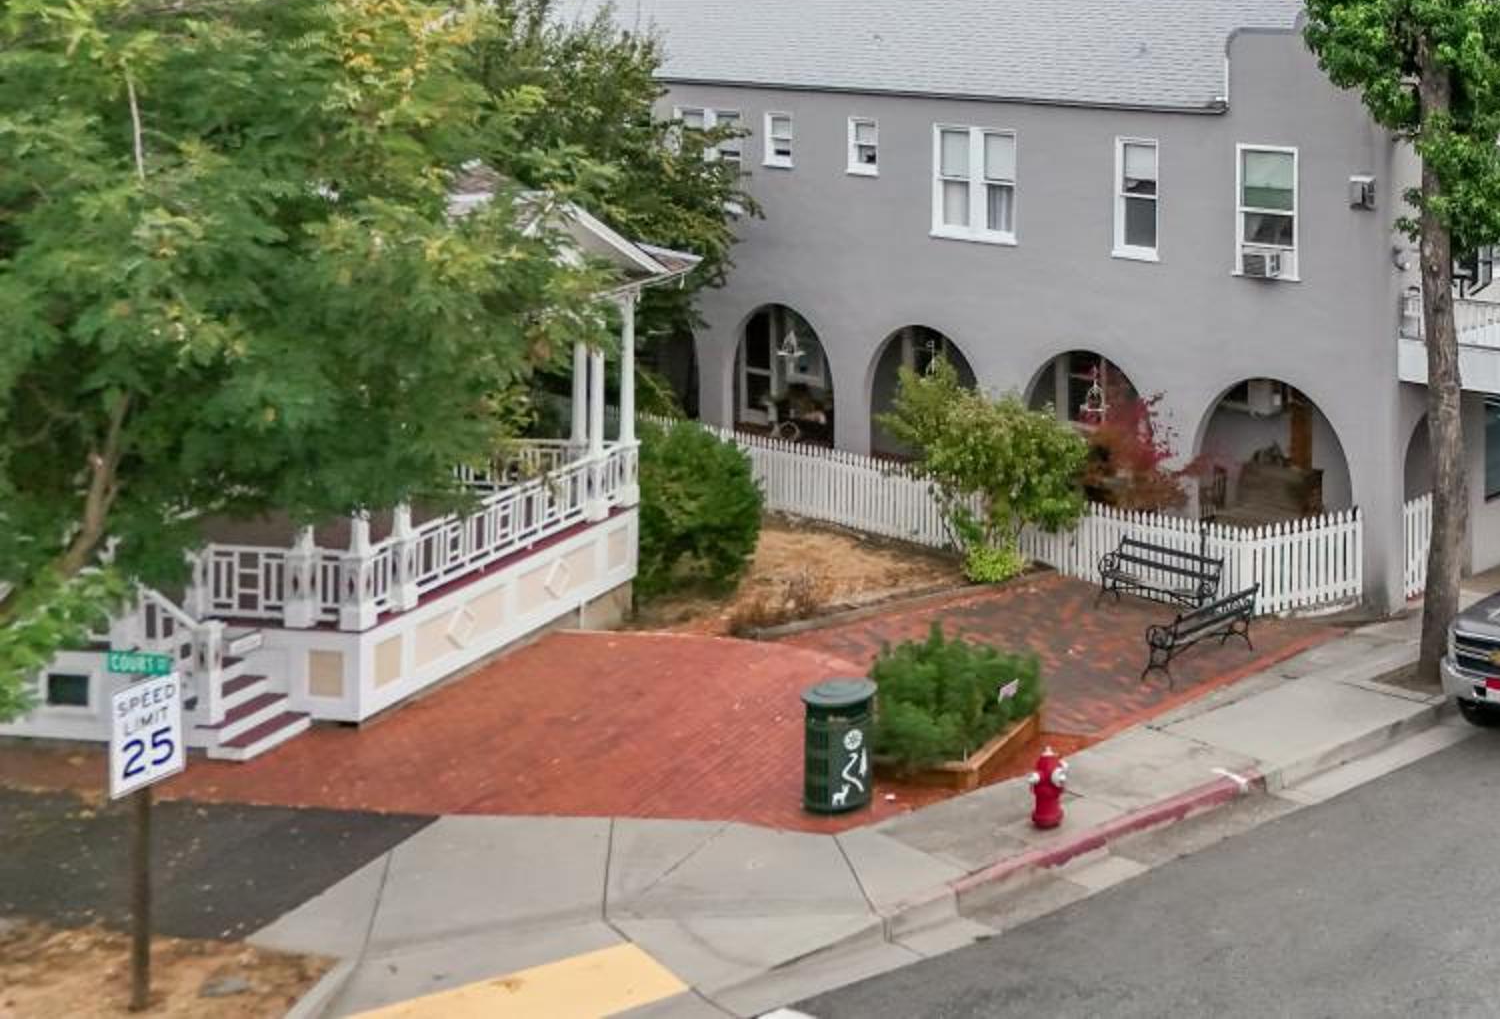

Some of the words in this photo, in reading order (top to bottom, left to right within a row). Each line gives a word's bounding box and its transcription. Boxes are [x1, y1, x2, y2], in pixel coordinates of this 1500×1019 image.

[118, 684, 175, 717] SPEED
[124, 706, 168, 737] LIMIT
[122, 727, 174, 779] 25
